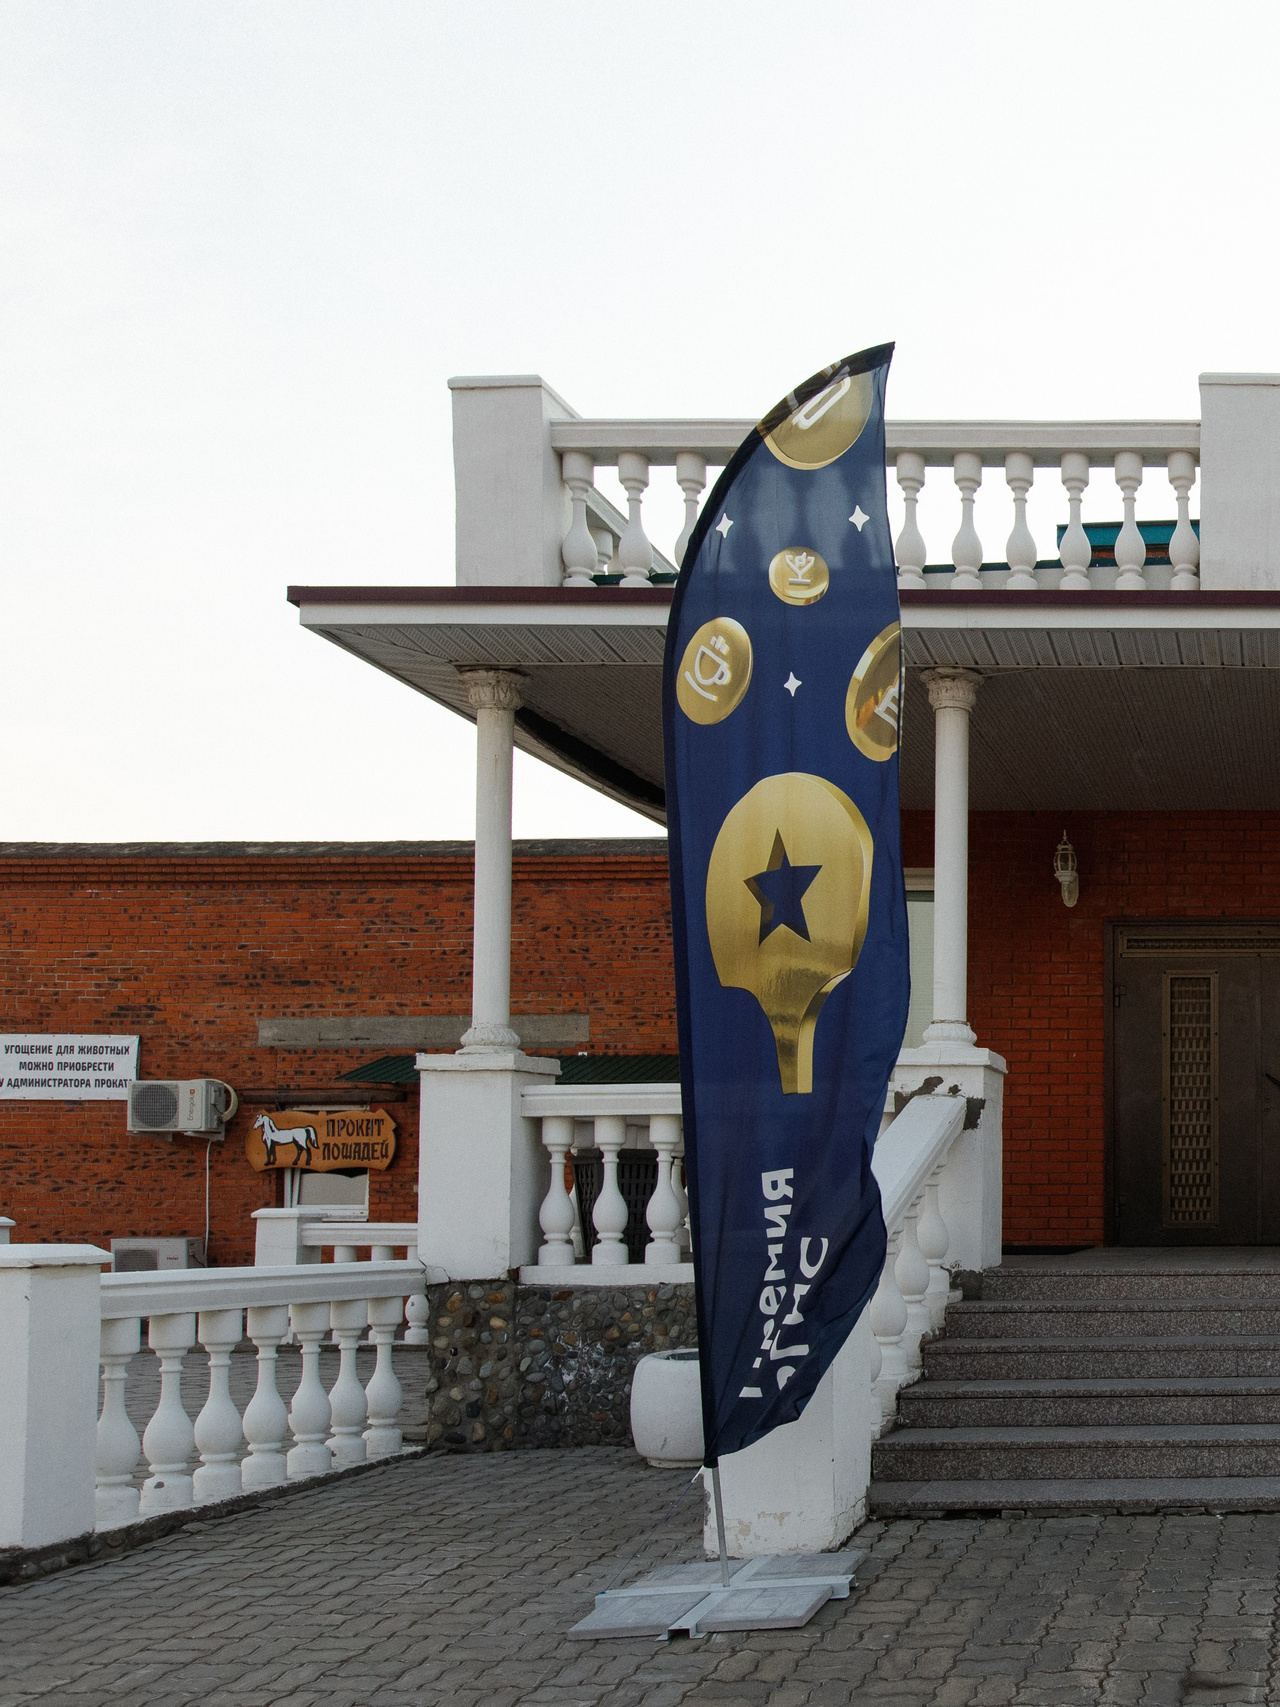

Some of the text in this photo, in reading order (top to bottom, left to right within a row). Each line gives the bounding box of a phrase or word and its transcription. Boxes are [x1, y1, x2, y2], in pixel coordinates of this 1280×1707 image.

[4, 1044, 130, 1056] УГОЩЕНИЕ ДЛЯ ЖИВОТНЫХ
[19, 1061, 114, 1071] МОЖНО ПРИОБРЕСТИ
[7, 1078, 91, 1089] АДМИНИСТРАТОРА
[94, 1079, 132, 1088] ПРОКАТ
[326, 1118, 384, 1137] ПРОКАТ
[322, 1139, 389, 1161] ЛОШАДЕЙ
